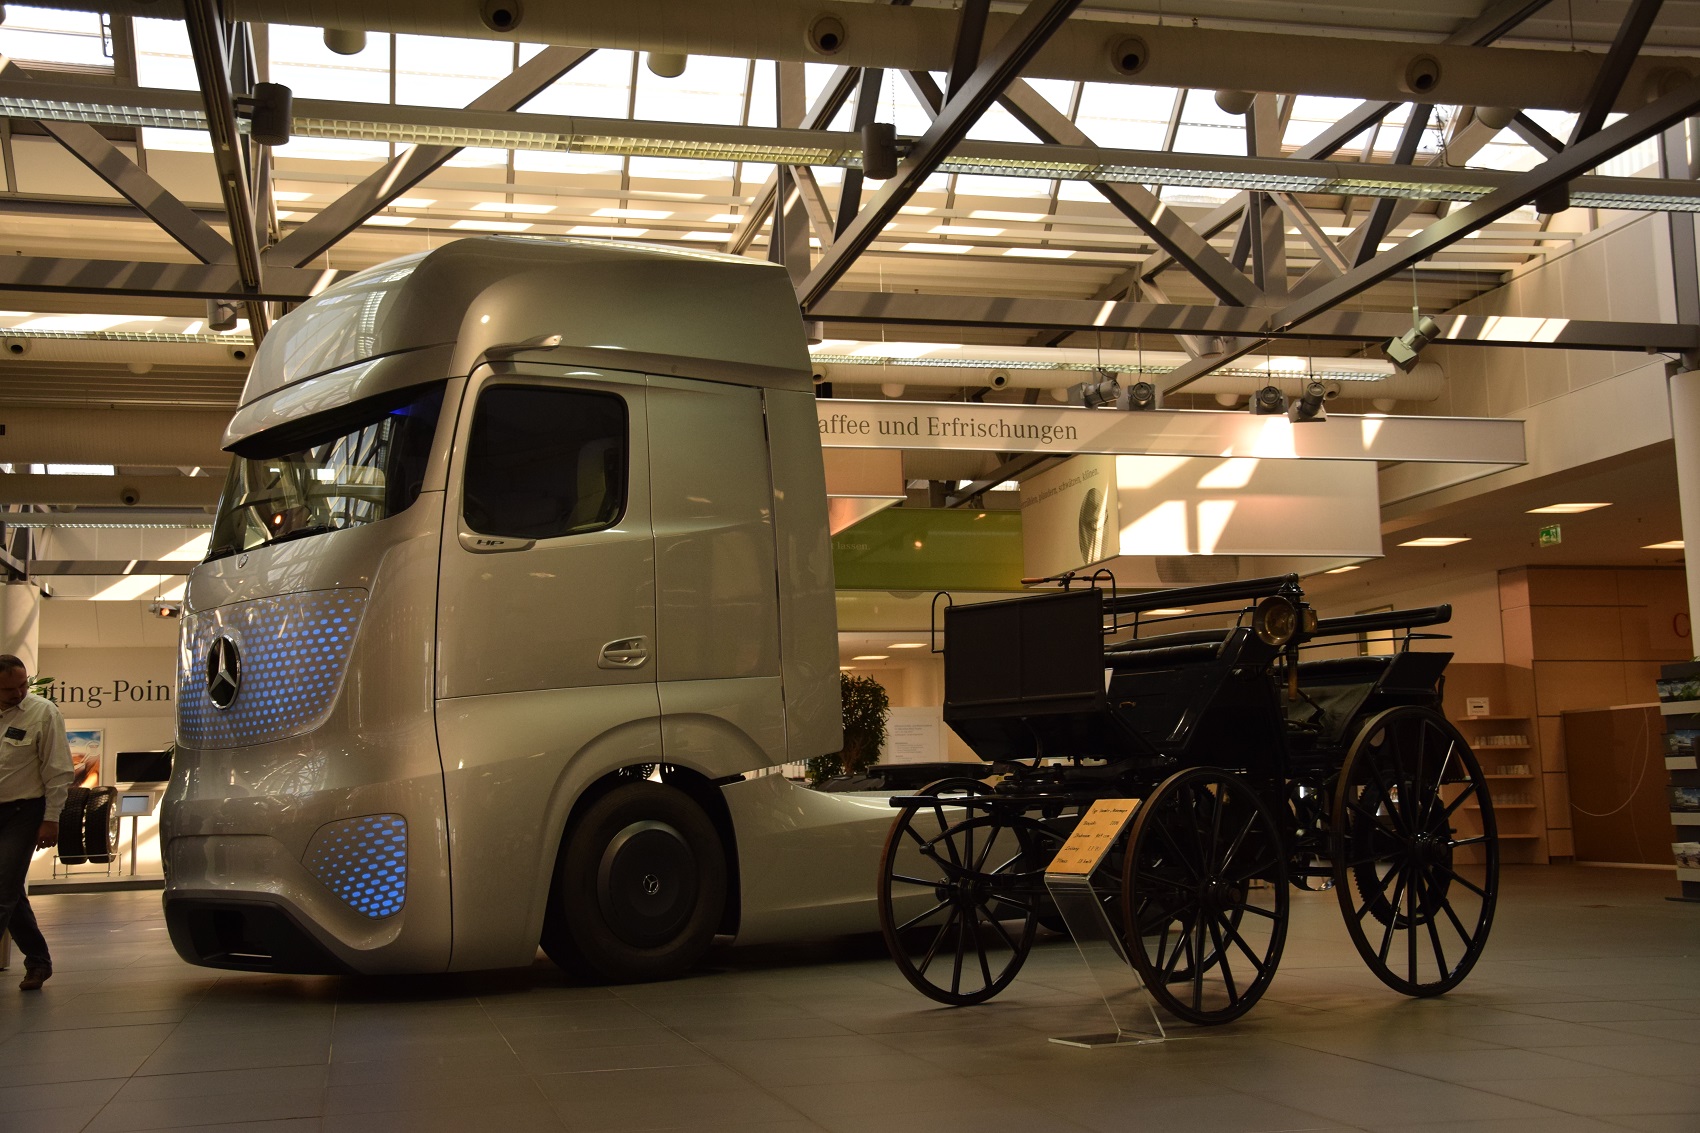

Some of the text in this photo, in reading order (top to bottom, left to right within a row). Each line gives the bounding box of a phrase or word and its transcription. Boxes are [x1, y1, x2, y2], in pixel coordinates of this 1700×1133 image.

[818, 414, 1079, 444] affee und Erfrischungen
[837, 541, 871, 551] lassen.
[47, 680, 175, 709] ting-Poin
